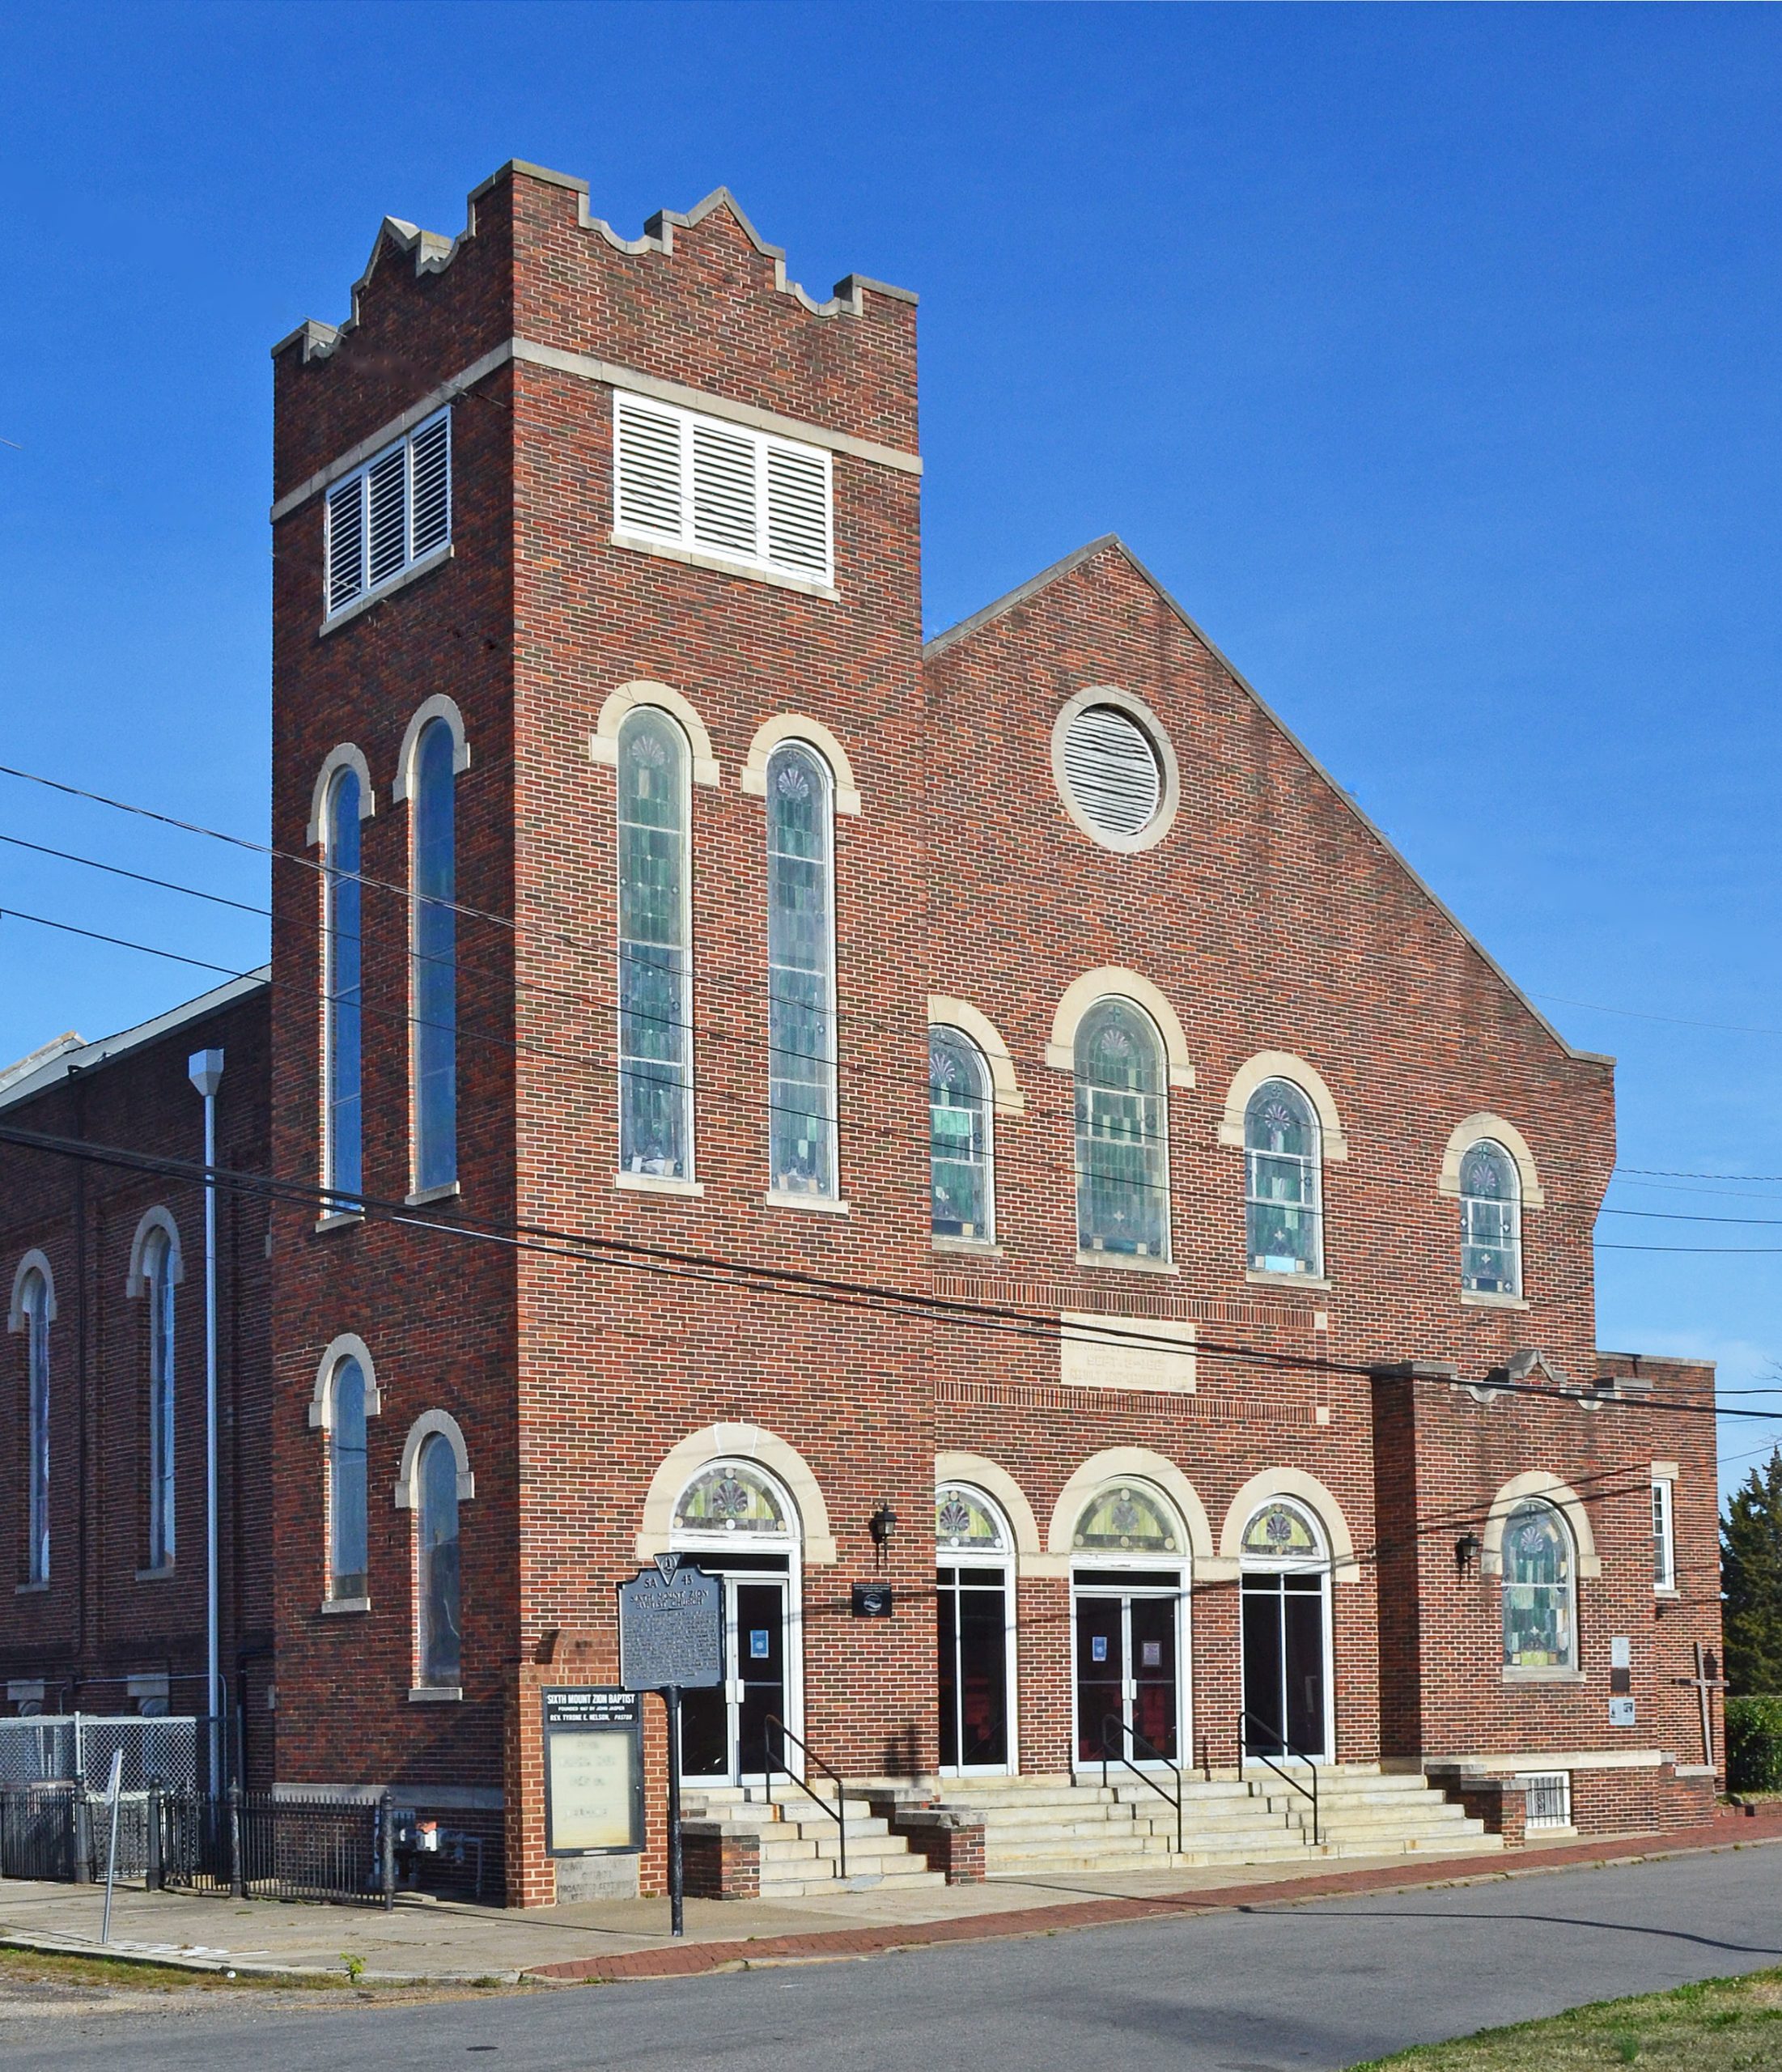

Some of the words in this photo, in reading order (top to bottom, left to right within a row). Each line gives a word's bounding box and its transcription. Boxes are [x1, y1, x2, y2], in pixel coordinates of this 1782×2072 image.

[644, 1578, 658, 1589] SA
[657, 1590, 685, 1600] MOUNT
[689, 1589, 709, 1599] ZION
[636, 1600, 667, 1610] BAPTIST
[672, 1598, 703, 1607] CHURCH
[547, 1694, 566, 1705] SIXTH
[568, 1694, 592, 1705] MOUNT
[592, 1694, 608, 1705] ZION
[609, 1694, 635, 1705] BAPTIST
